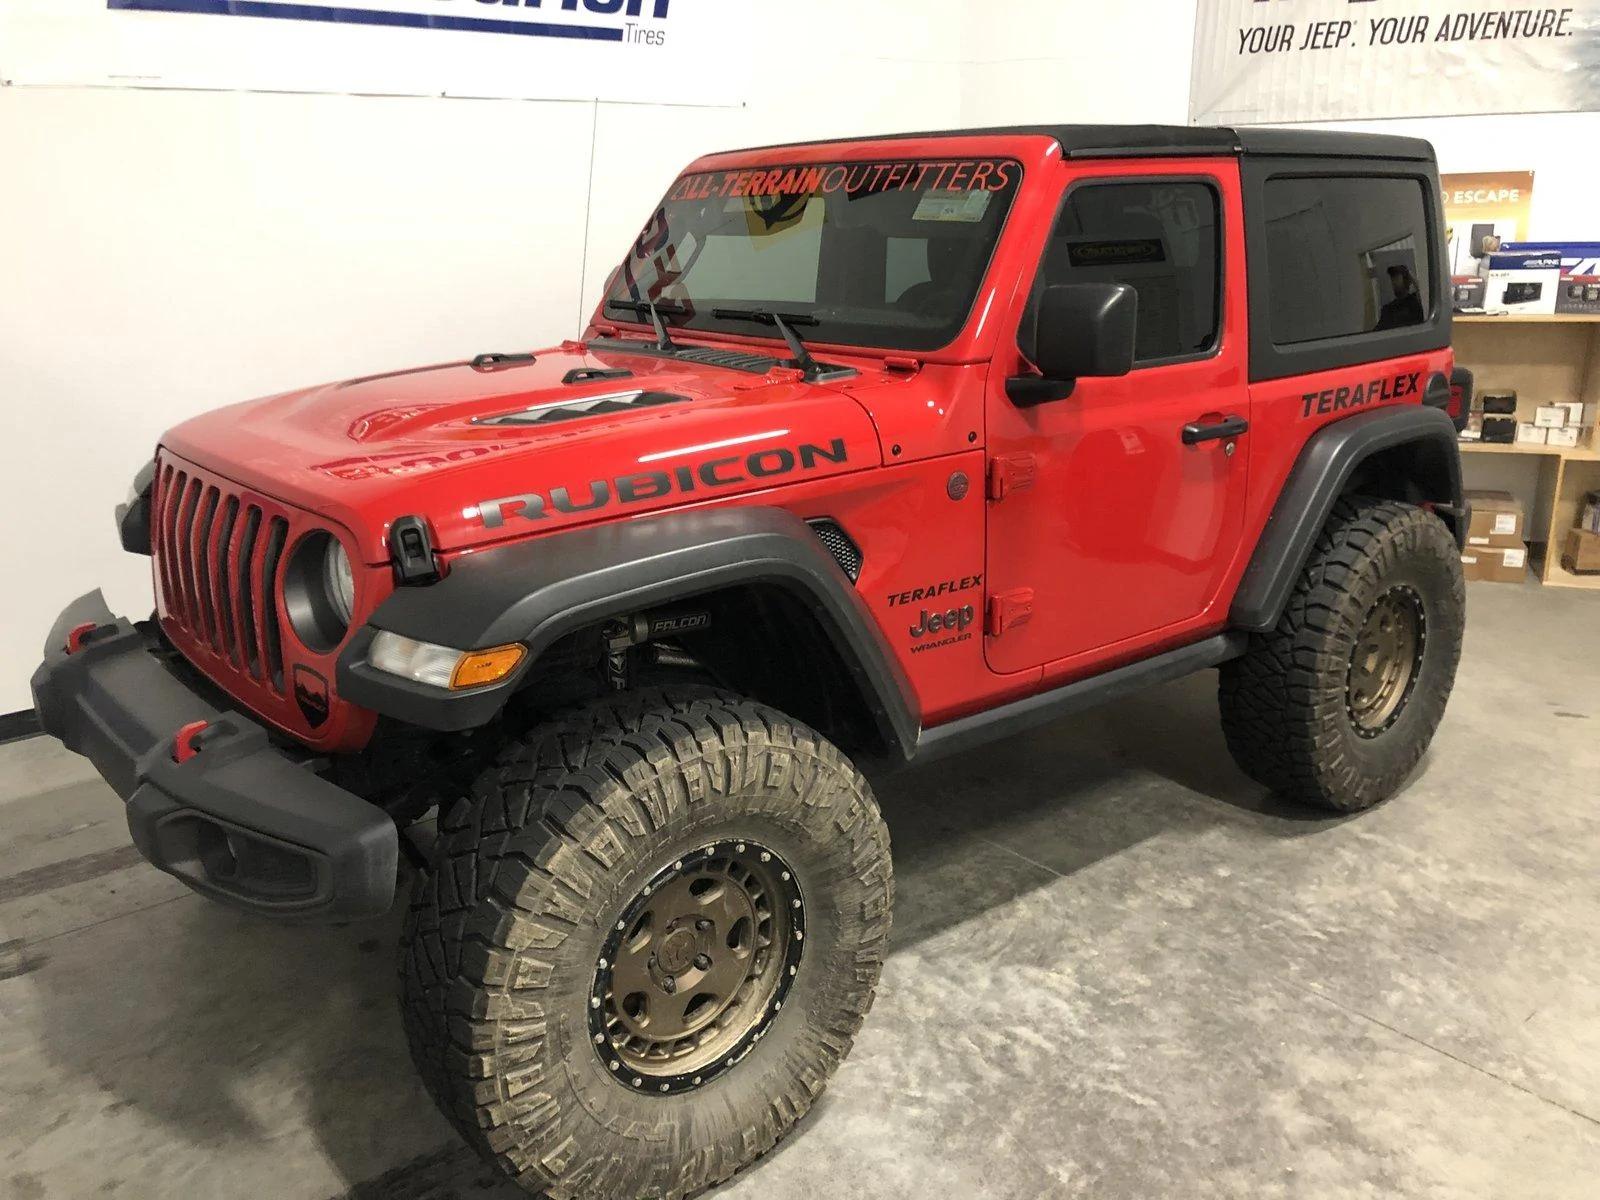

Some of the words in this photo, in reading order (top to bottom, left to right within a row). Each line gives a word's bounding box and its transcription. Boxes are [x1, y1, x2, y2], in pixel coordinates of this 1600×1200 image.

[625, 23, 666, 46] Tires
[1239, 25, 1295, 55] YOUR
[1369, 16, 1430, 46] YOUR
[1434, 8, 1574, 42] ADVENTURE.
[1453, 189, 1520, 204] ESCAPE
[1302, 372, 1420, 418] TERAFLEX
[479, 438, 848, 528] RUBICON
[887, 573, 983, 608] TERAFLEX
[654, 614, 707, 633] FALCON
[909, 605, 974, 638] Jeep
[910, 633, 972, 654] WRANGLER
